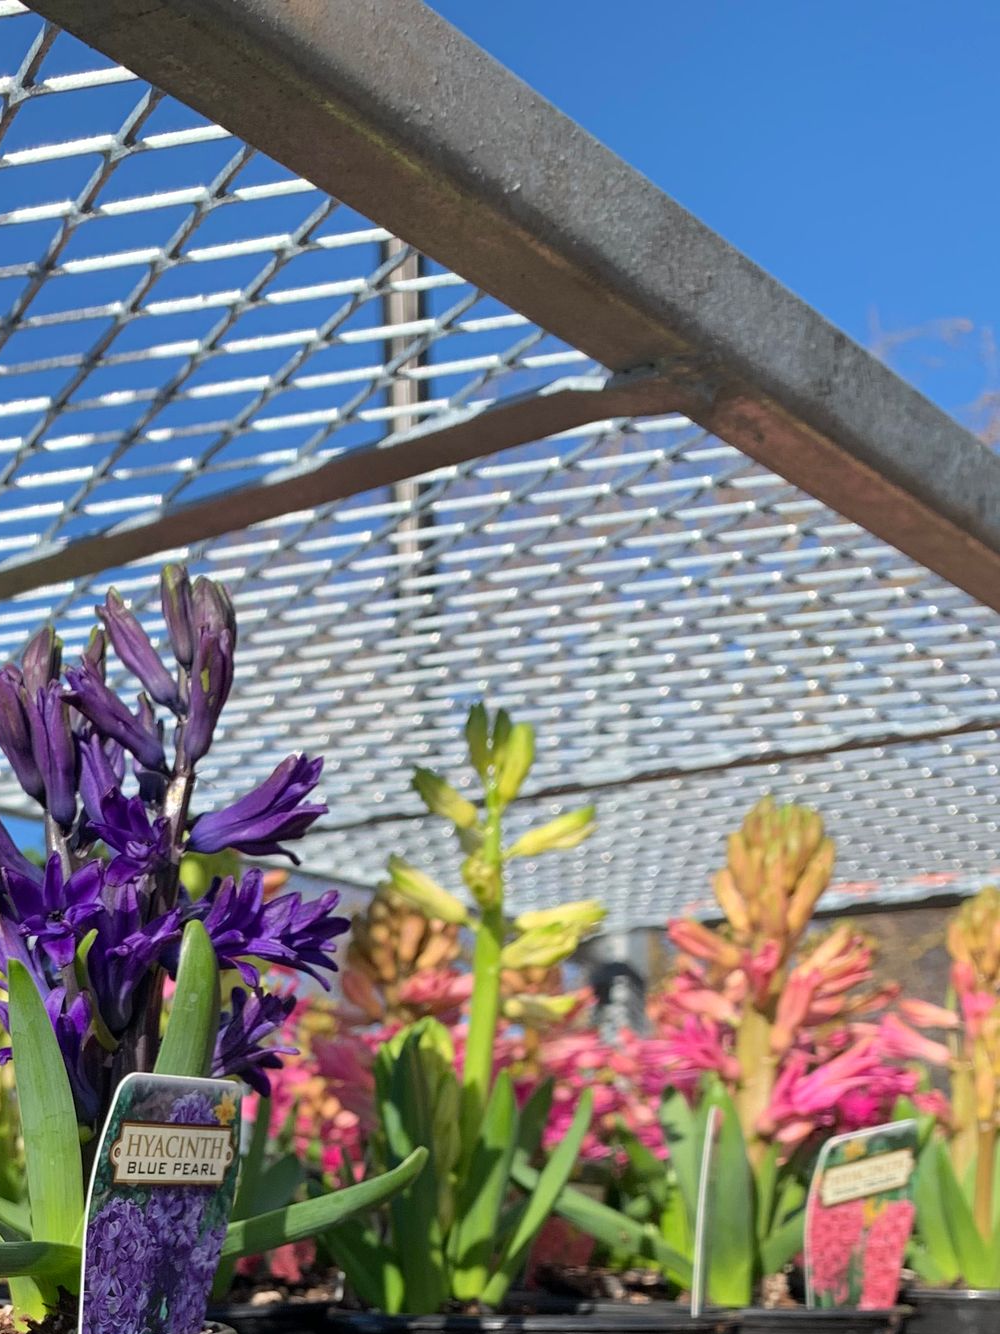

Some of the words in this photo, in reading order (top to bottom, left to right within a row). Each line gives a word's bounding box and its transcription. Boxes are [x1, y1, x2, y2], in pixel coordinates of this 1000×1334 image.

[126, 1133, 225, 1160] HYACINTH
[127, 1161, 168, 1175] BLUE
[173, 1162, 217, 1176] PEARL
